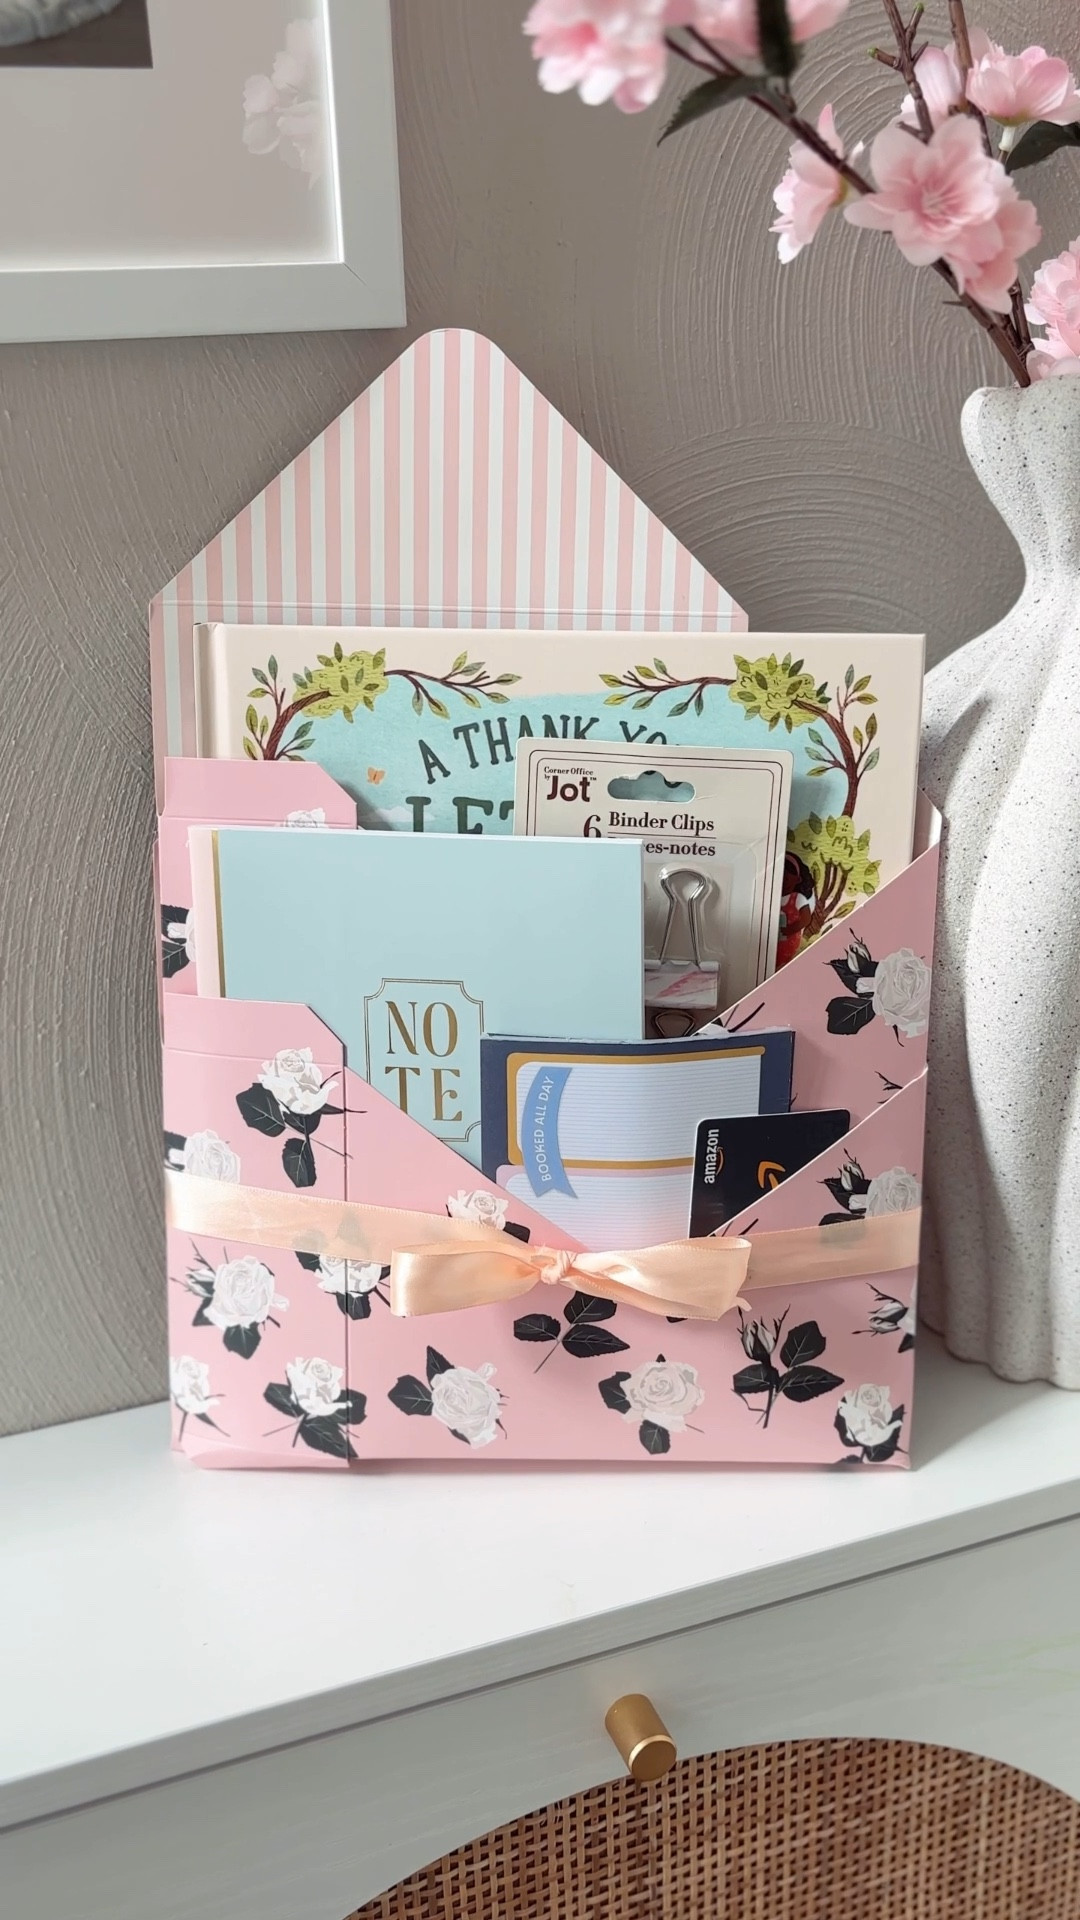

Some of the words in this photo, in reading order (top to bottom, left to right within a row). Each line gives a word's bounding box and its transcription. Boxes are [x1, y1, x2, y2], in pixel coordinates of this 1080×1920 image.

[418, 739, 451, 785] A
[544, 766, 570, 775] Corner
[570, 767, 594, 776] Office
[583, 814, 602, 838] 6
[608, 811, 668, 829] Binder
[671, 814, 715, 836] Clips
[643, 842, 716, 857] es-notes
[385, 1000, 459, 1057] NO
[385, 1066, 463, 1122] TE
[538, 1075, 555, 1102] DAY
[534, 1105, 547, 1126] ALL
[534, 1129, 552, 1182] BOOKED
[704, 1128, 720, 1184] amazon
